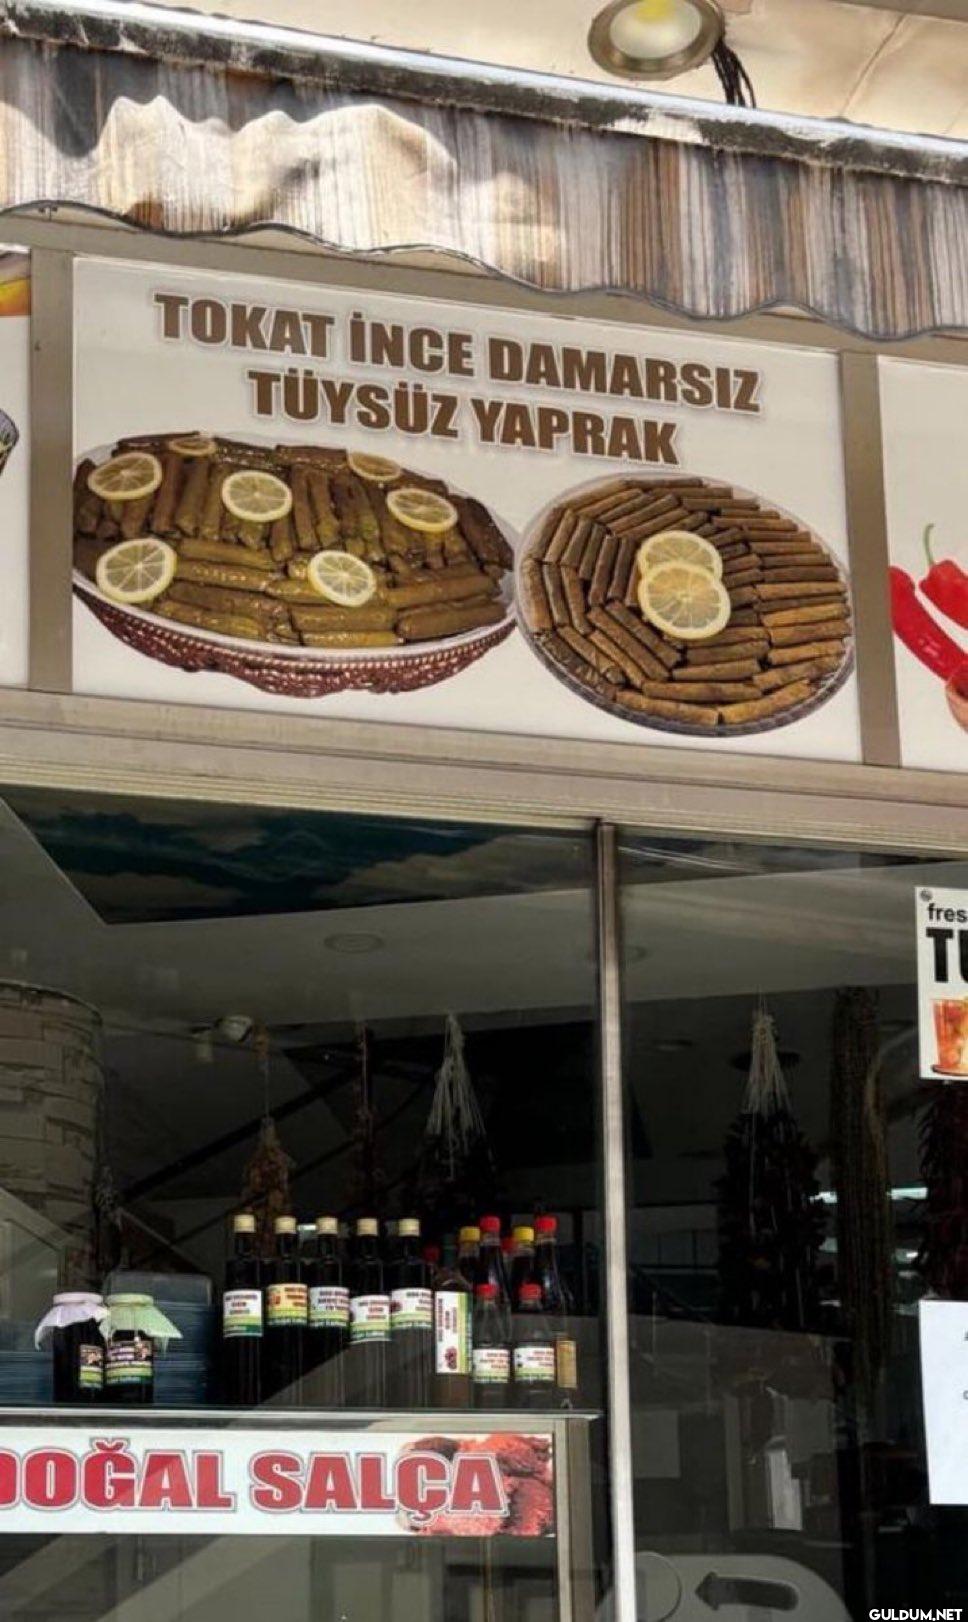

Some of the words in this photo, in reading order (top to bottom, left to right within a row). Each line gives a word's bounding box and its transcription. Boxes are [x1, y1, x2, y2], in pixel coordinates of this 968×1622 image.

[154, 292, 334, 358] TOKAT
[350, 311, 475, 377] İNCE
[488, 337, 761, 413] DAMARSIZ
[249, 367, 459, 438] TÜYSÜZ
[471, 399, 681, 465] YAPRAK
[249, 1449, 509, 1522] SALÇA
